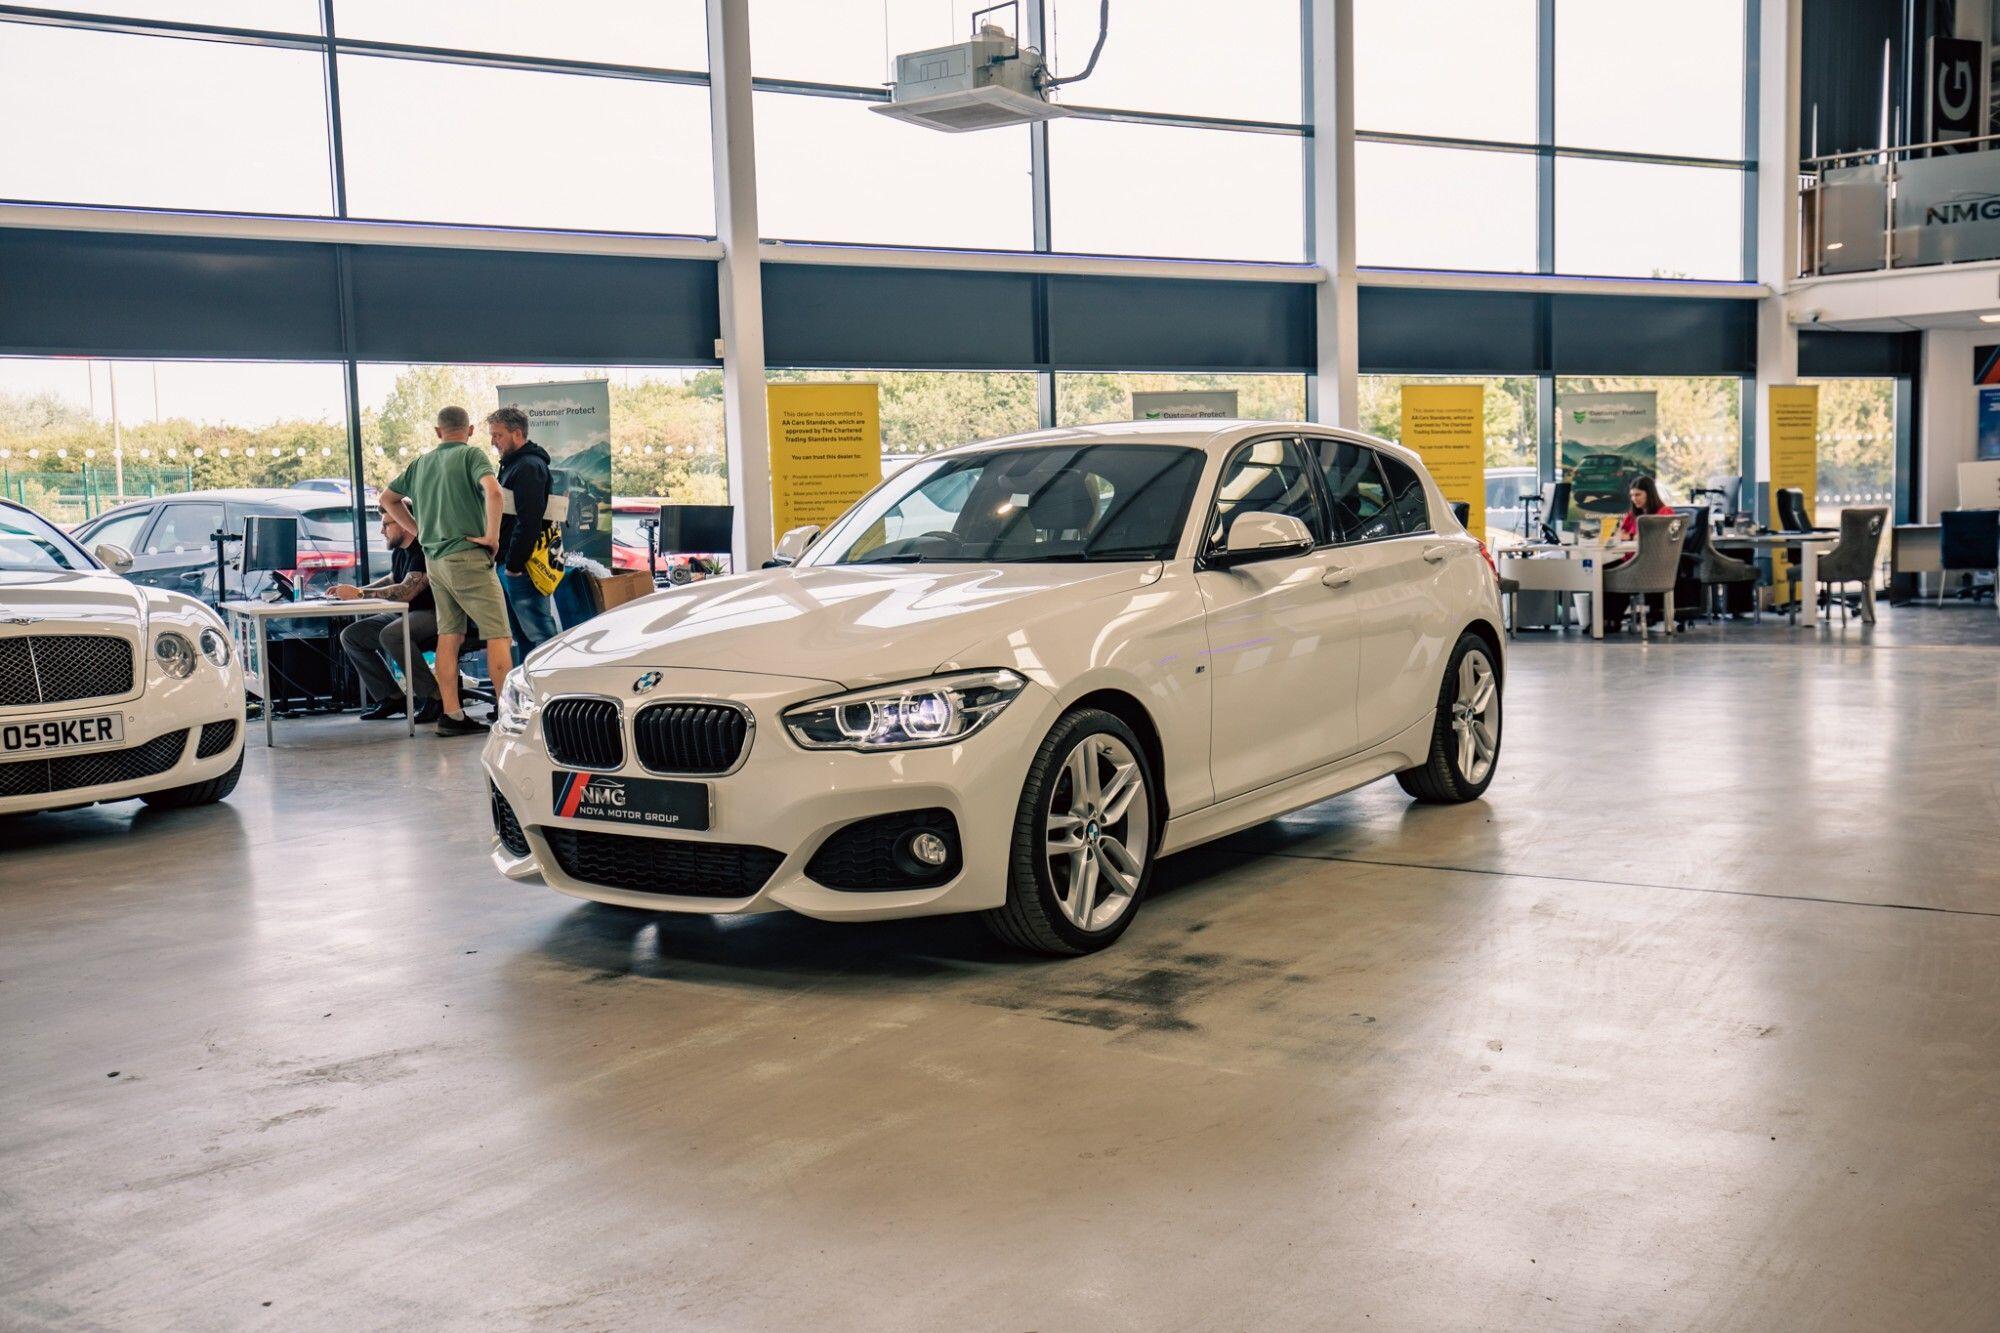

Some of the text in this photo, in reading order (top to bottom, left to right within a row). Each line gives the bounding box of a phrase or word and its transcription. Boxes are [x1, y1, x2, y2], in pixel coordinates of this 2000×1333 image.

[1926, 200, 2000, 225] NMG
[529, 406, 596, 417] Customer Protect
[580, 785, 626, 806] NMG
[580, 806, 679, 822] NOYA MOTOR GROUP
